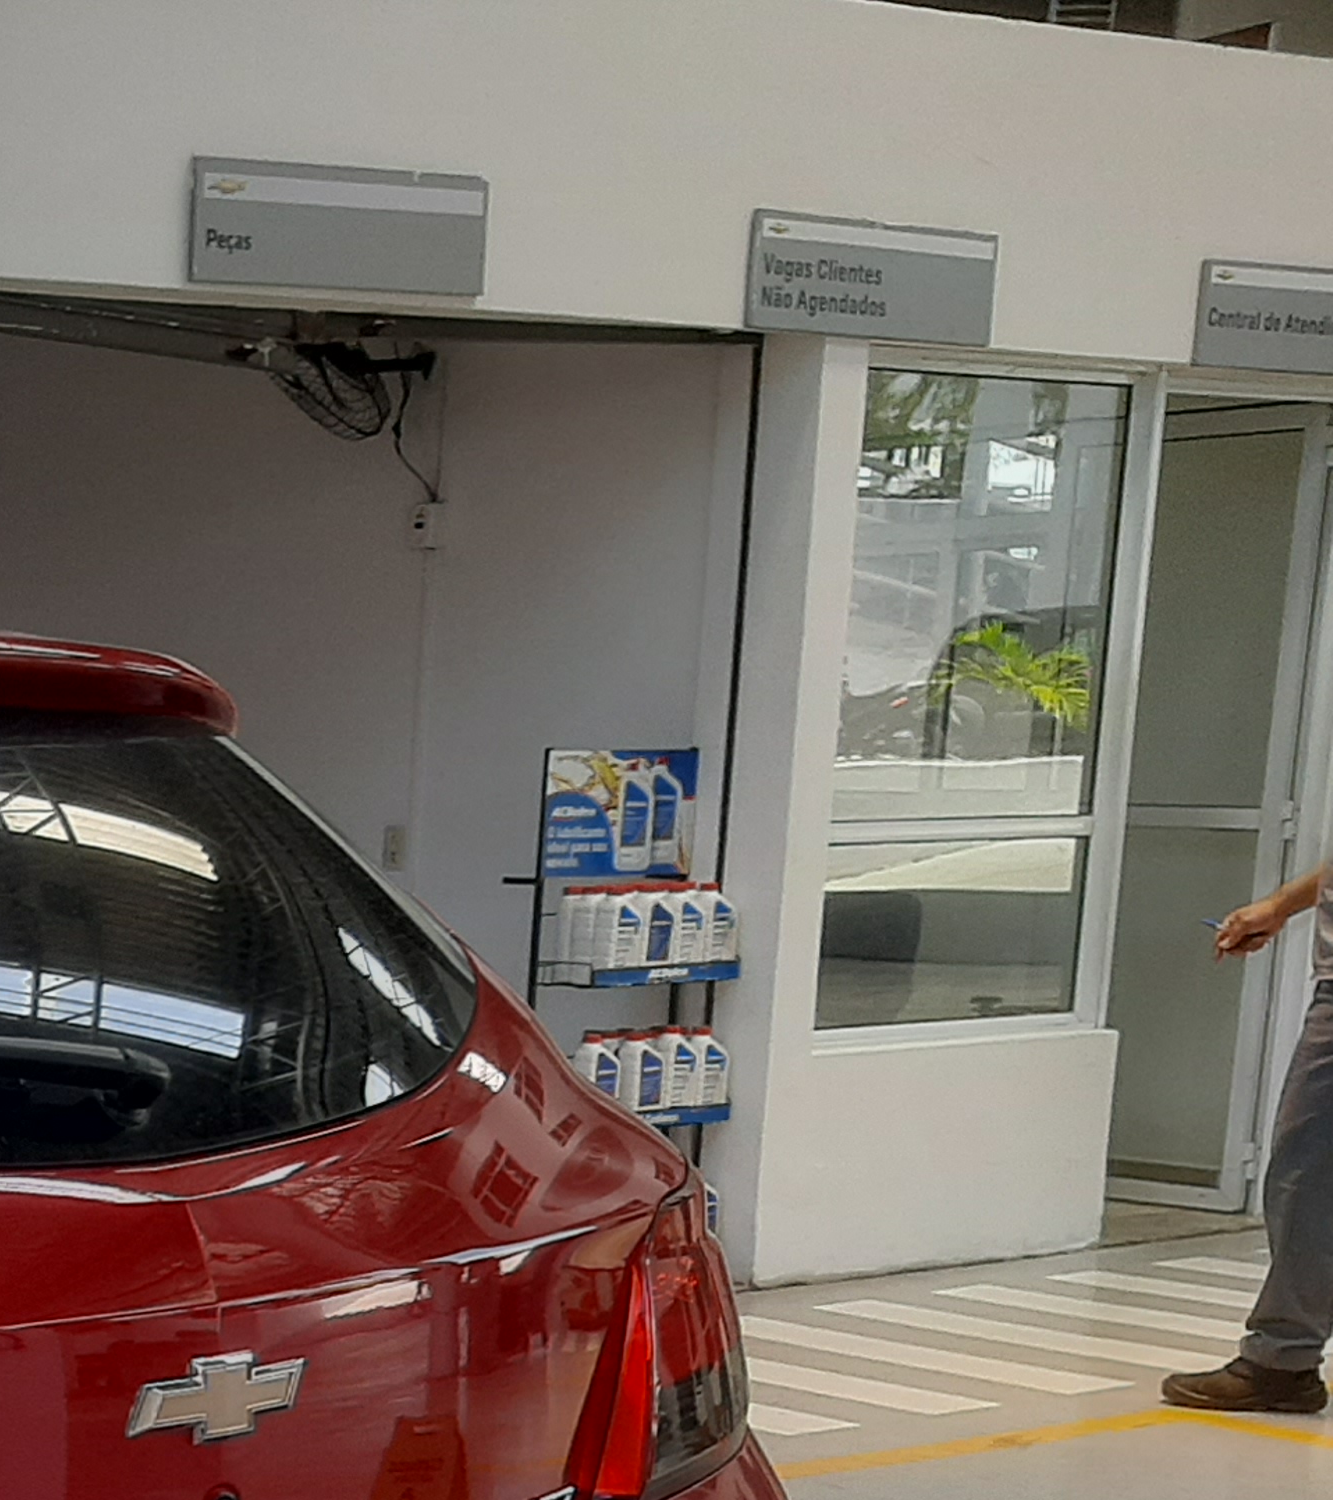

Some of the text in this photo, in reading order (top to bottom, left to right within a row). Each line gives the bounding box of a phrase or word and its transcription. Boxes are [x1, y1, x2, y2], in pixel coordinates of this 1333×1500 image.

[205, 228, 252, 253] Peças
[764, 253, 882, 285] Vagas Clientes
[761, 286, 886, 317] Não Agendados
[1209, 306, 1261, 330] Central
[1264, 311, 1281, 332] de
